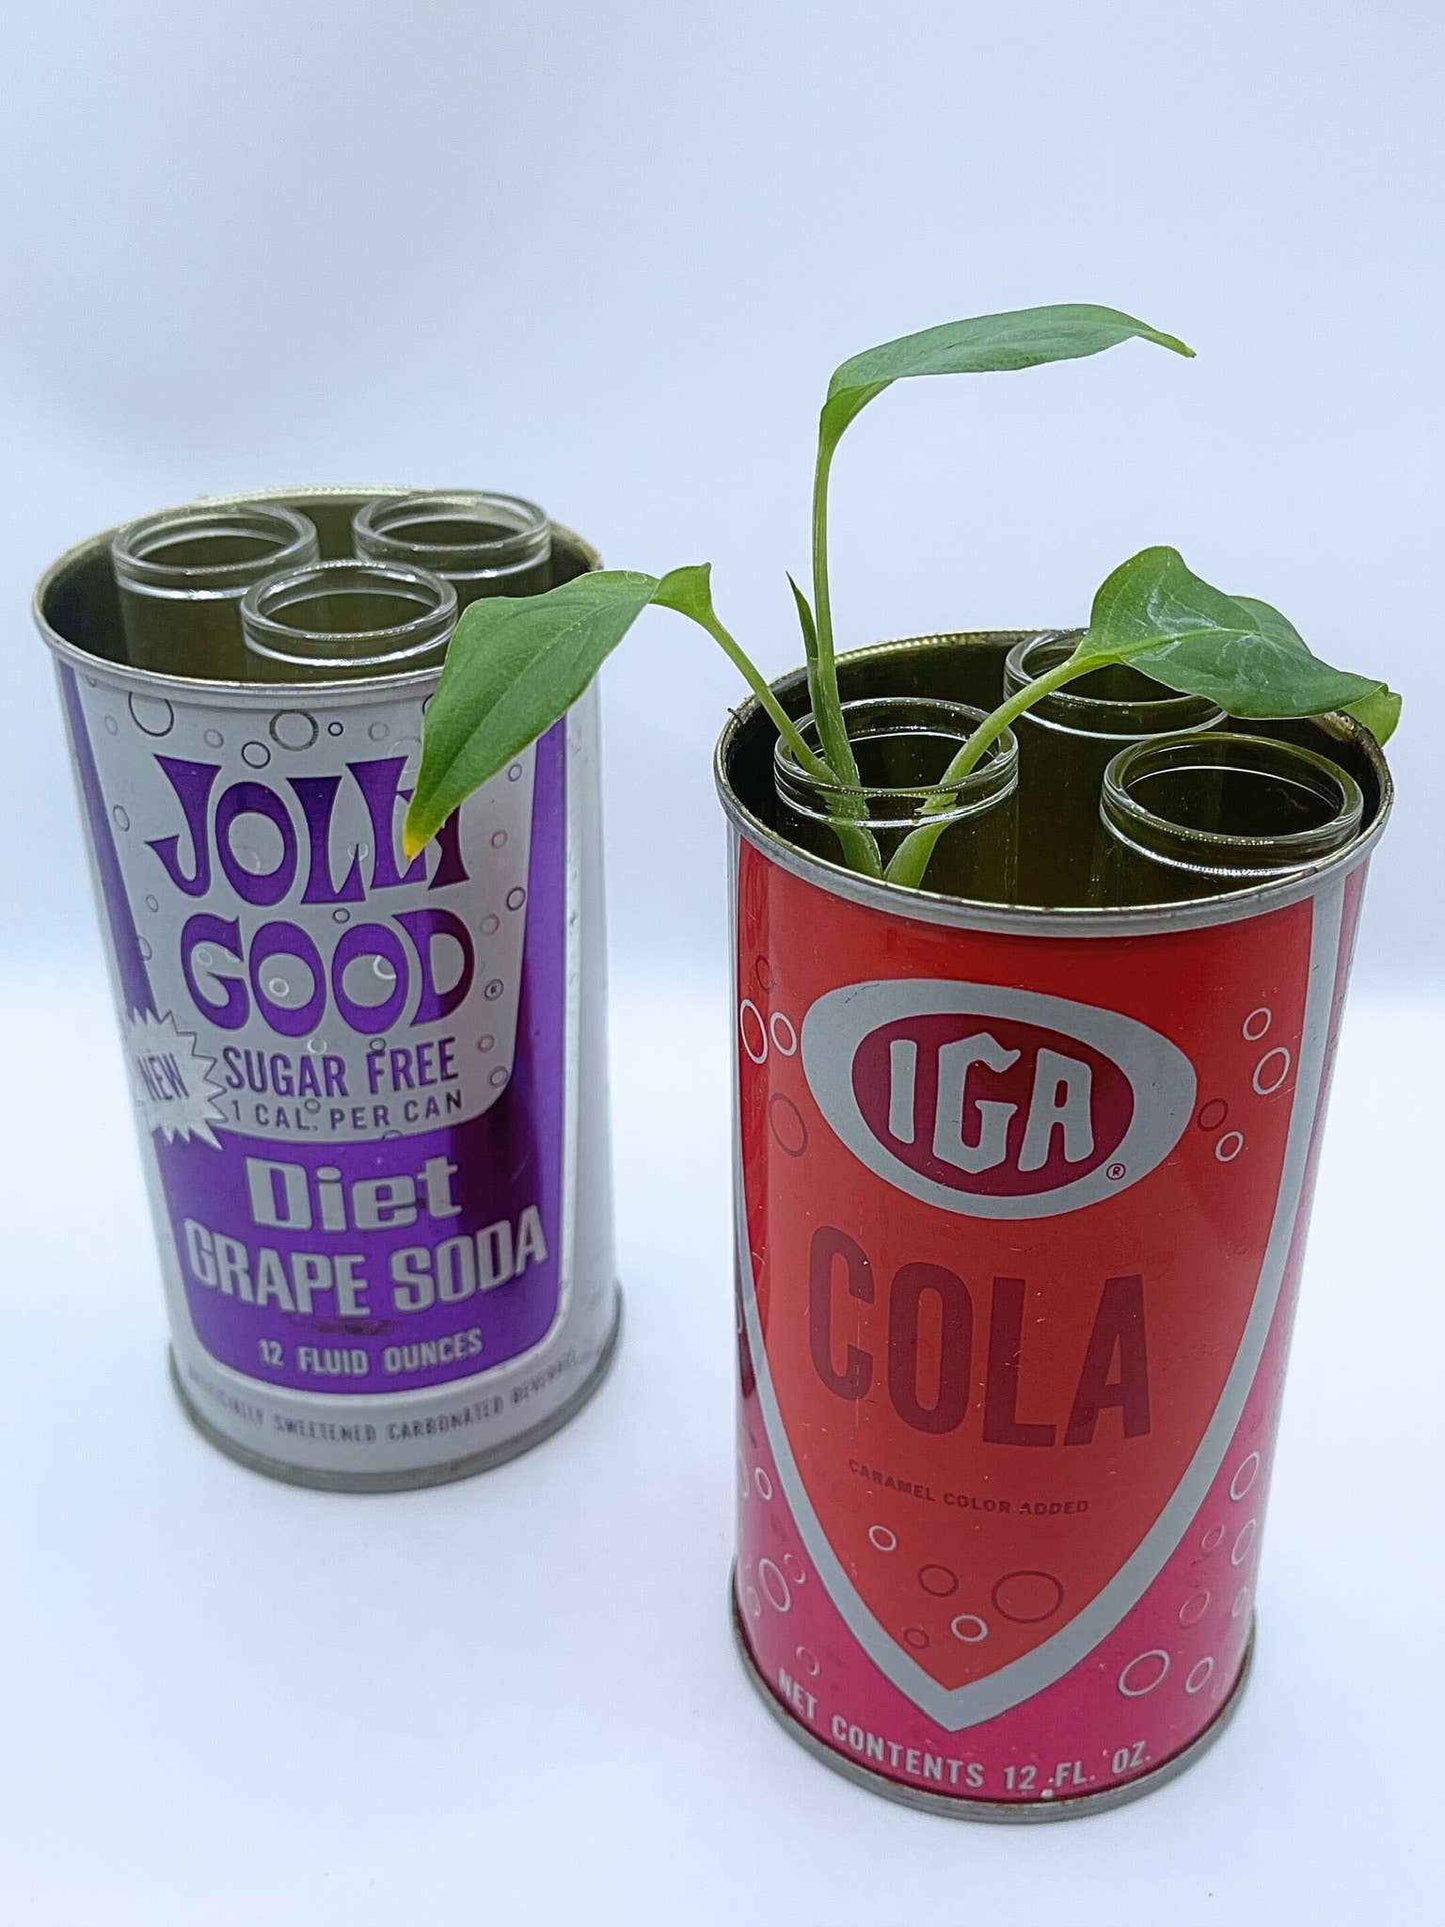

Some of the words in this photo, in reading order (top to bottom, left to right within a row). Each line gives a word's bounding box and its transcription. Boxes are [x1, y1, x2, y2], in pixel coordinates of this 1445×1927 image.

[180, 908, 476, 1037] GOOD
[137, 1051, 190, 1102] NEW
[222, 1044, 348, 1098] SUGAR
[366, 1036, 460, 1096] FREE
[230, 1100, 242, 1122] 1
[254, 1103, 319, 1132] CAL.
[329, 1102, 393, 1131] PER
[403, 1089, 463, 1124] CAN
[888, 1031, 1095, 1174] IGA
[245, 1155, 463, 1234] Diet
[183, 1217, 372, 1318] GRAPE
[391, 1204, 549, 1314] SODA
[258, 1340, 285, 1369] 12
[299, 1346, 370, 1377] FLUID
[383, 1329, 483, 1375] OUNCES
[808, 1225, 1151, 1448] COLA
[386, 1395, 504, 1441] CARBONATED
[848, 1457, 937, 1503] CARAMEL
[943, 1491, 1012, 1515] COLOR
[1018, 1499, 1090, 1516] ADDED
[777, 1667, 818, 1721] NET
[830, 1714, 985, 1790] CONTENTS
[1003, 1764, 1038, 1791] 12
[1054, 1760, 1096, 1788] FL.
[1111, 1740, 1151, 1775] OZ.
